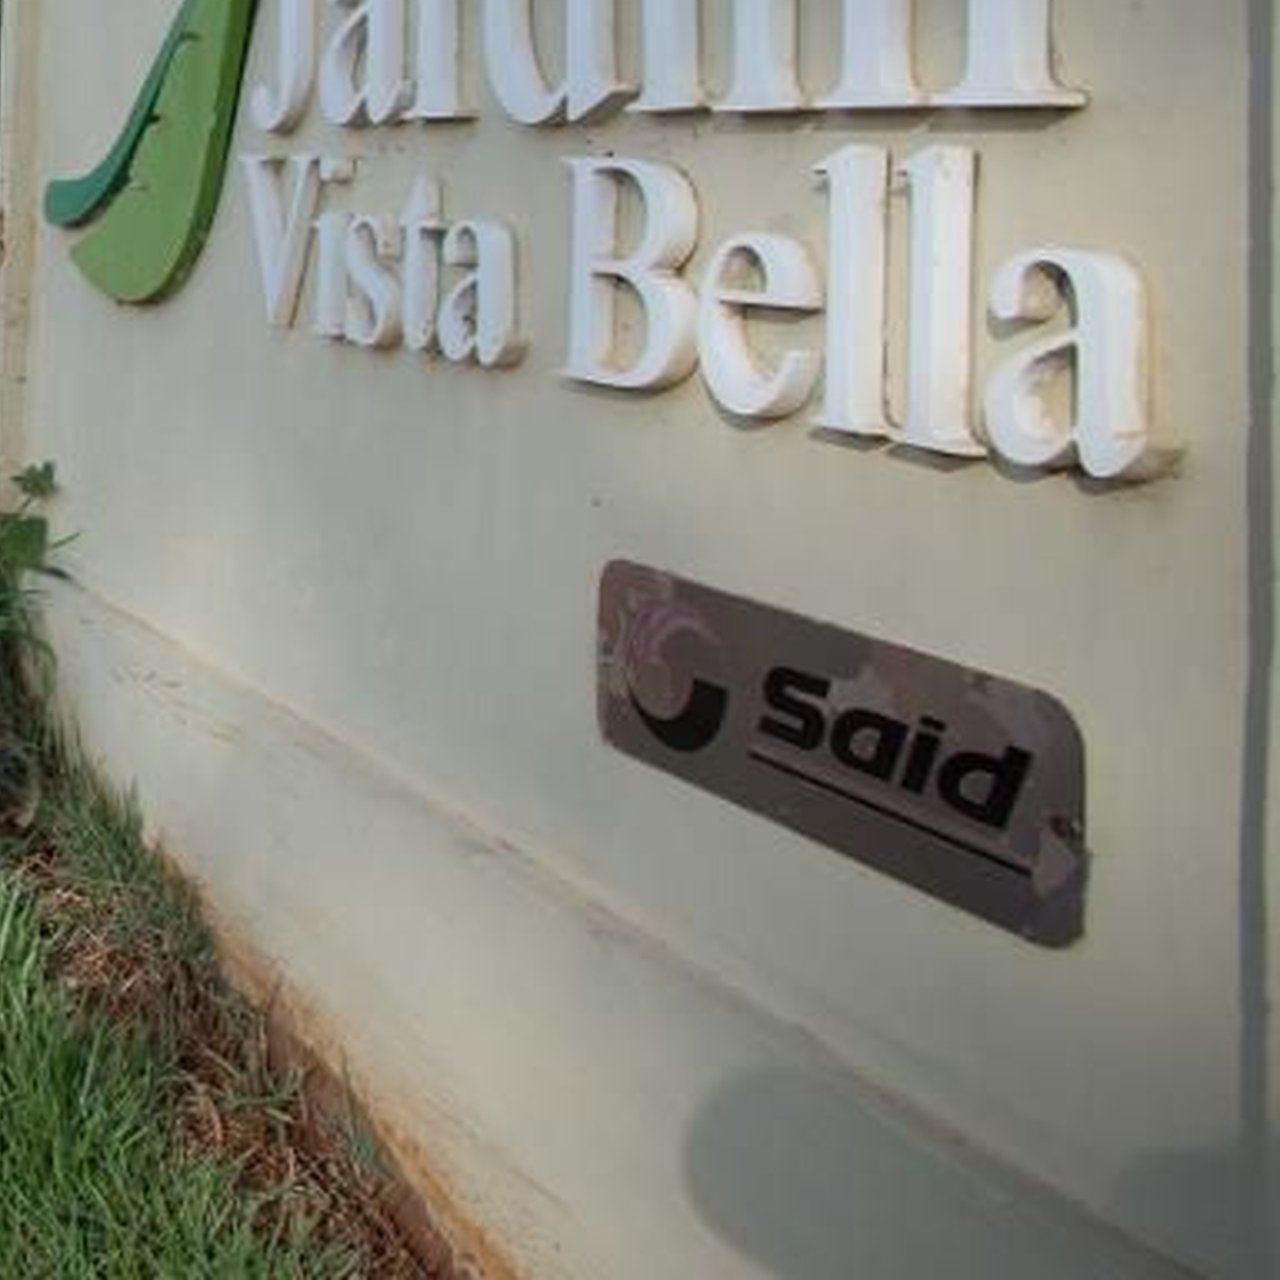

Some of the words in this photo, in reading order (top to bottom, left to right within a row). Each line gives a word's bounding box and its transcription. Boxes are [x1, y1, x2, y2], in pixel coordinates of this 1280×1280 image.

[240, 154, 530, 368] Vista
[560, 144, 1148, 480] Bella
[756, 665, 1036, 831] said
